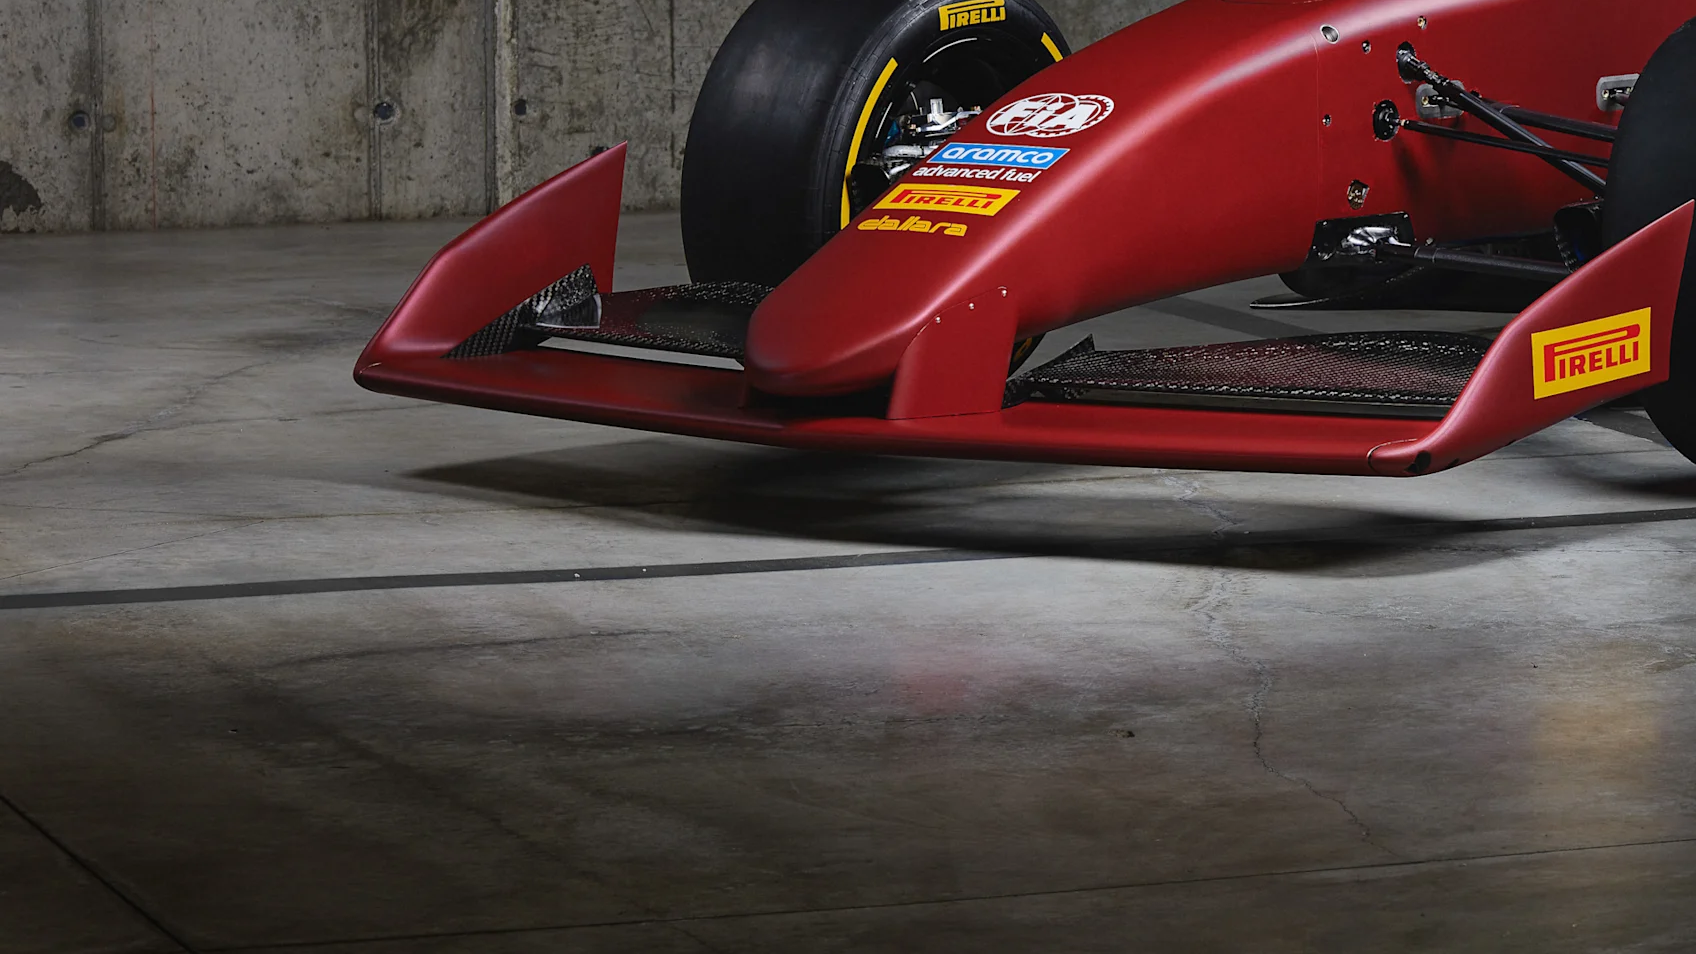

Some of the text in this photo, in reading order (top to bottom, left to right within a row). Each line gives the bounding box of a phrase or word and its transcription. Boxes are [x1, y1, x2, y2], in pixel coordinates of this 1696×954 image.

[942, 146, 1054, 165] aramco
[912, 165, 1041, 183] advanced fuel
[890, 189, 1002, 209] PIRELLI
[857, 215, 968, 236] dallara
[1543, 323, 1641, 383] PIRELLI
